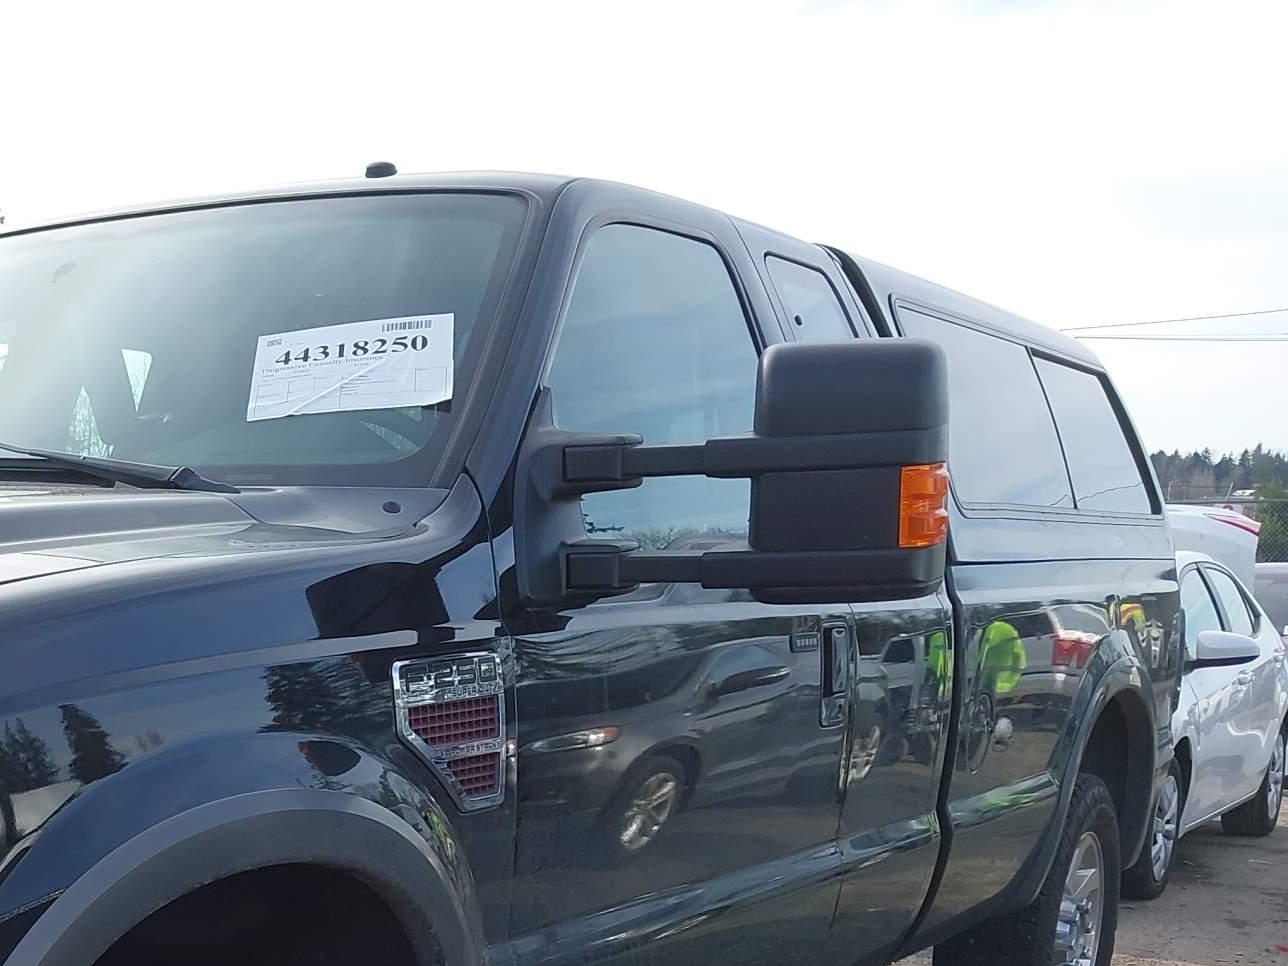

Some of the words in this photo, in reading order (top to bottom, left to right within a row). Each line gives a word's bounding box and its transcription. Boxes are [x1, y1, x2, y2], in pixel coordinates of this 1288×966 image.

[275, 335, 428, 365] 44318250
[399, 656, 497, 694] F-250
[451, 686, 477, 698] SUPER
